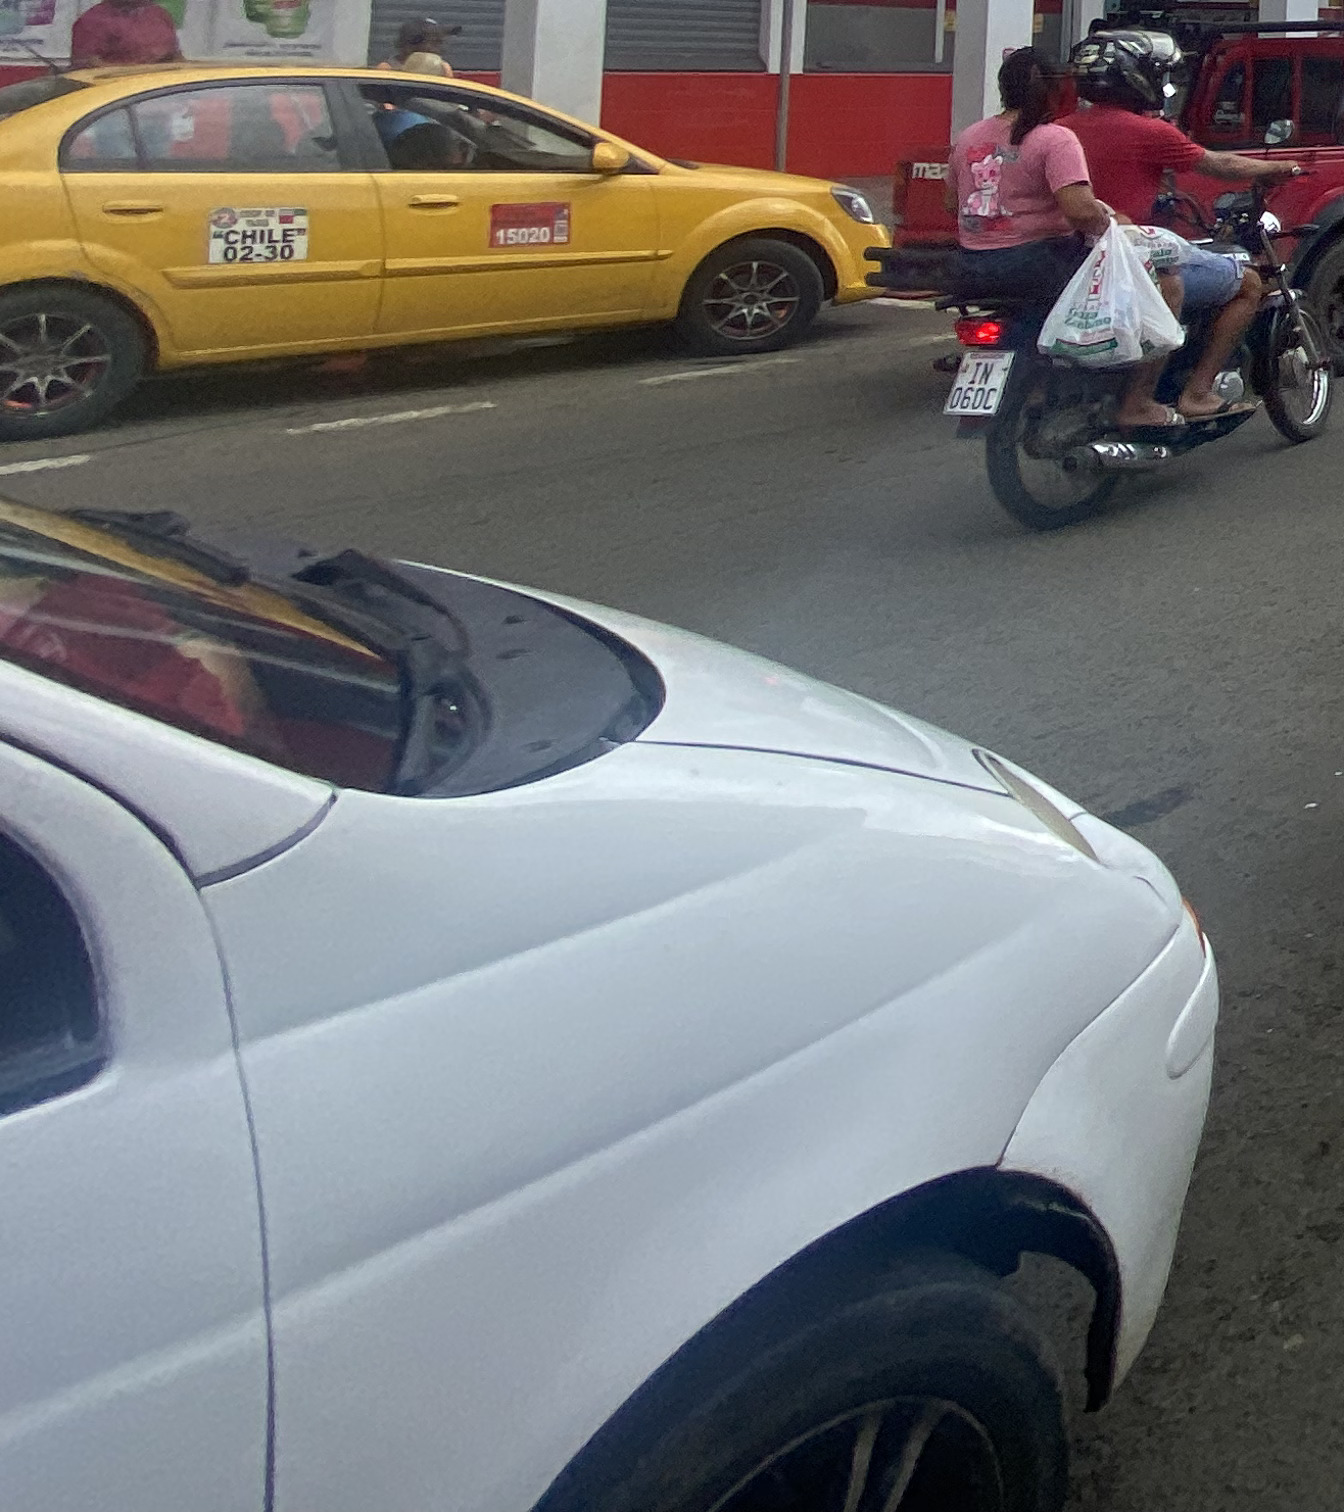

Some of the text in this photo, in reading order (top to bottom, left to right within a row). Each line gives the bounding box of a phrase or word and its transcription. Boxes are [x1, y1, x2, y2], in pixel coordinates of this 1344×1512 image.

[912, 162, 949, 179] maz
[496, 227, 551, 245] 15020
[223, 244, 295, 262] 02-30
[968, 362, 994, 385] IN
